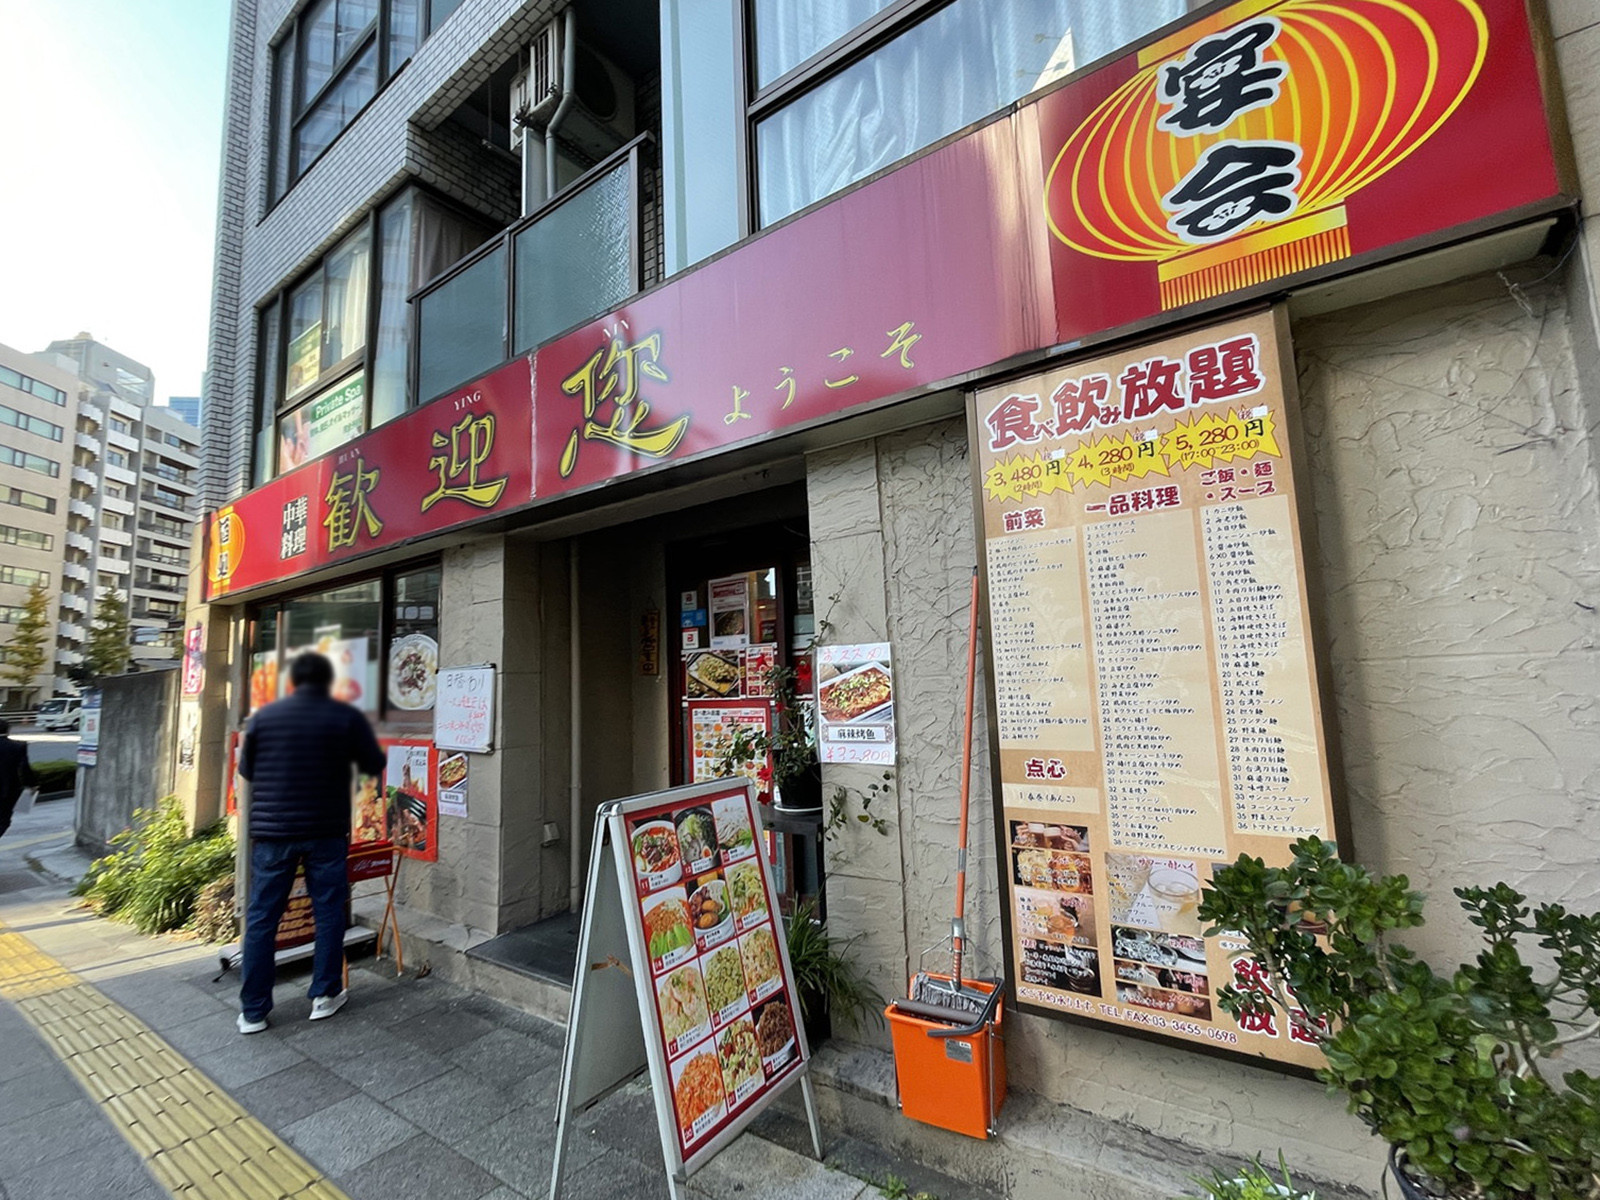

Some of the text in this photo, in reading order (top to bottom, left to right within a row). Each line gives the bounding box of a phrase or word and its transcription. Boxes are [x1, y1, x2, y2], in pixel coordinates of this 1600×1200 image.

[1159, 17, 1302, 241] 宴会
[723, 321, 924, 428] ようこそ
[345, 385, 361, 401] Spa
[454, 391, 481, 411] YING
[987, 336, 1261, 449] 食べ飲み放題
[283, 497, 308, 528] 中華
[1086, 486, 1179, 516] 一品料理
[1005, 509, 1043, 531] 前菜
[280, 527, 307, 559] 料理
[1026, 759, 1065, 778] 点心
